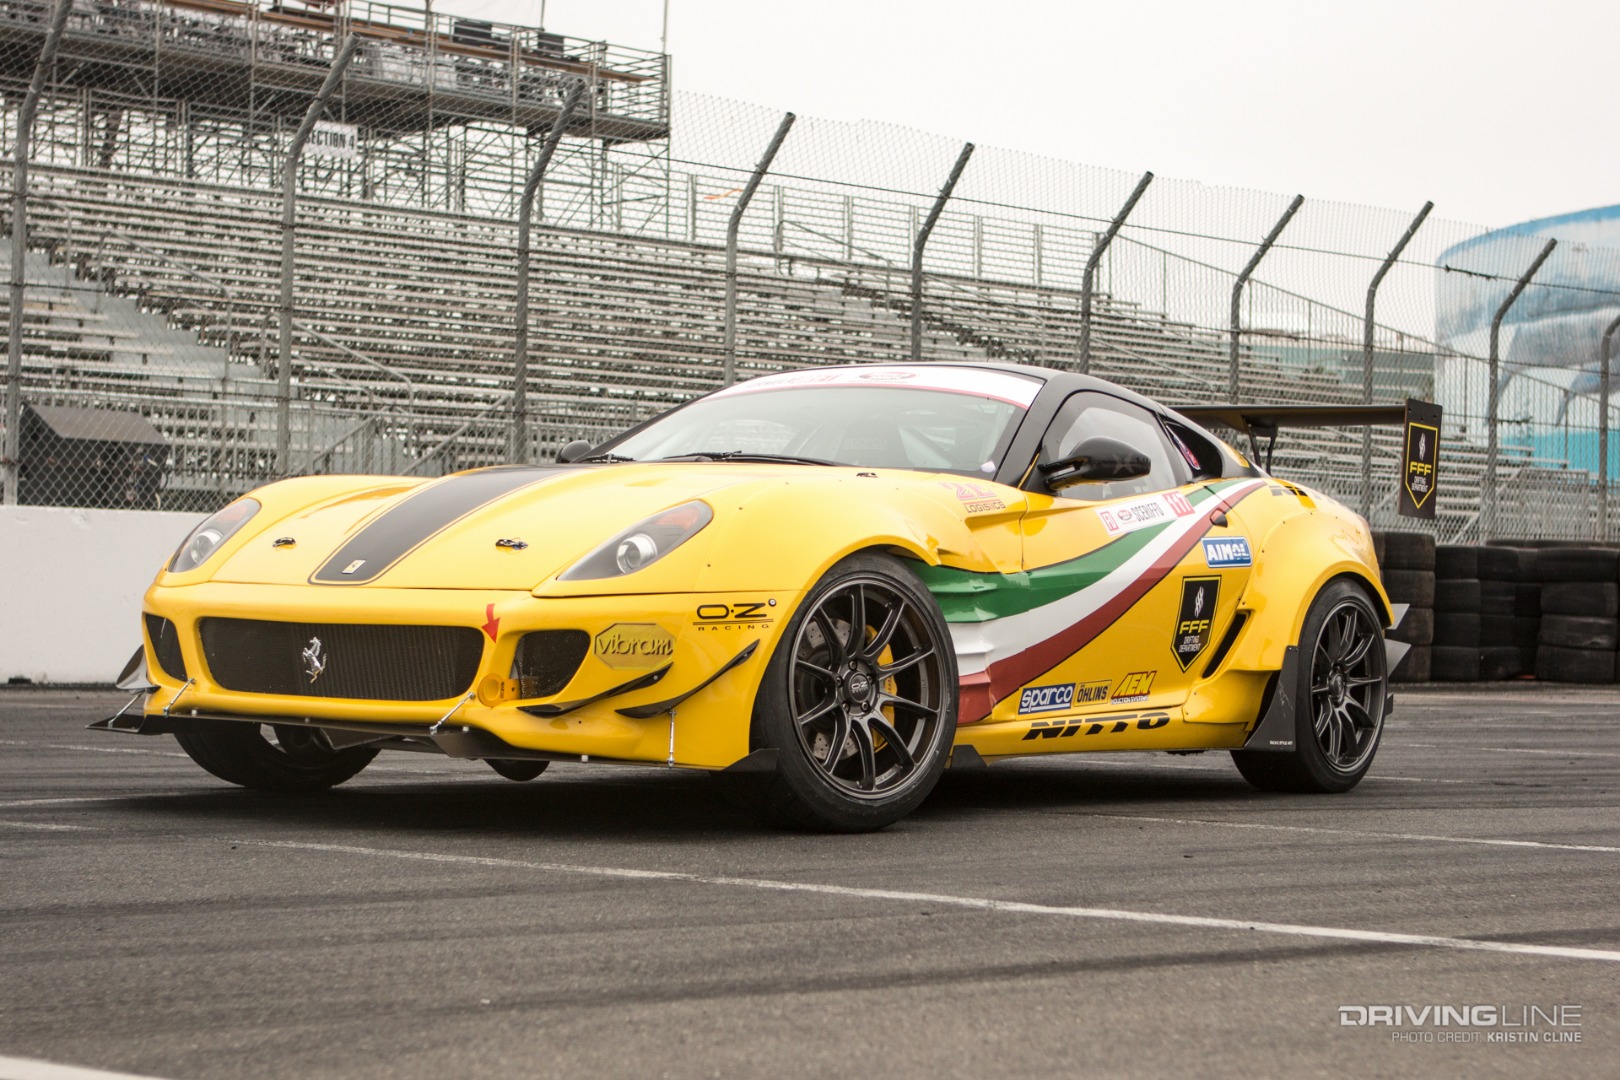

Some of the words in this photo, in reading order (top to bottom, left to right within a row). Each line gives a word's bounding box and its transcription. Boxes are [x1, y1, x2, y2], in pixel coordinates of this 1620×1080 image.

[349, 135, 354, 150] 4
[1410, 461, 1431, 475] FFF
[963, 501, 1006, 513] LOGISTICS
[1163, 492, 1191, 515] 117
[1206, 543, 1250, 561] AIMOL
[1179, 620, 1209, 634] FFF
[598, 634, 674, 655] vibram
[1077, 684, 1109, 703] ÖHLINS
[1111, 671, 1157, 699] AEM
[1021, 686, 1073, 712] sparco
[1022, 712, 1170, 740] NITTO
